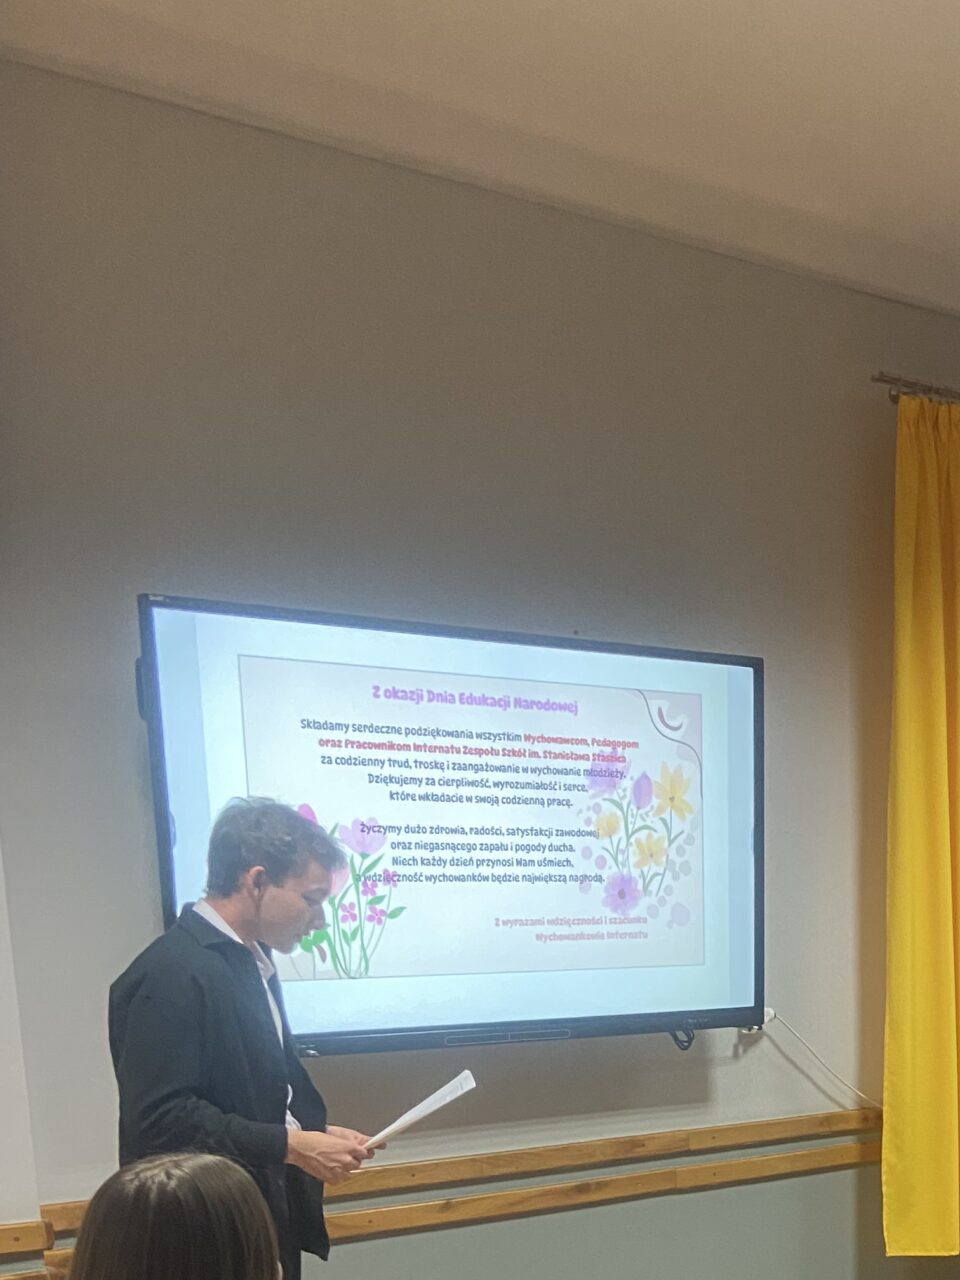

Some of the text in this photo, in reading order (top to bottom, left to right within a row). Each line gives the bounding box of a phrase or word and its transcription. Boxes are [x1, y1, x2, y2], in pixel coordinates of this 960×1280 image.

[372, 686, 578, 715] Z okazji Dnia Edukacji Narodowej
[301, 719, 639, 750] Składamy serdeczne podziękowania wszystkim Wychowawcom, Pedagogom
[319, 738, 626, 763] oraz Pracownikom Internatu Zespołu Szkół im. Stanisława Staszica
[321, 756, 332, 764] za
[335, 756, 385, 769] codzienny
[388, 759, 412, 769] trud,
[414, 760, 445, 772] troskę
[447, 761, 450, 770] i
[452, 762, 520, 774] zaangażowanie
[530, 766, 581, 776] wychowanie
[368, 774, 422, 787] Dziękujemy
[425, 778, 435, 786] za
[438, 778, 491, 789] cierpliwość,
[493, 780, 557, 791] wyrozumiałość
[559, 782, 561, 790] i
[389, 792, 416, 801] które
[419, 792, 463, 803] wkładacie
[475, 795, 499, 806] swoją
[502, 795, 545, 807] codzienną
[361, 822, 599, 839] Życzymy dużo zdrowia, radości, satysfakcji zawodowej
[391, 841, 411, 850] oraz
[415, 841, 477, 852] niegasnącego
[479, 842, 508, 852] zapału
[510, 842, 513, 851] i
[515, 844, 546, 853] pogody
[392, 856, 418, 866] Niech
[421, 857, 447, 867] każdy
[450, 856, 473, 866] dzień
[476, 858, 514, 868] przynosi
[516, 858, 535, 867] Wam
[364, 872, 423, 883] wdzięczność
[425, 873, 490, 884] wychowanków
[492, 874, 519, 883] będzie
[522, 874, 567, 884] największą
